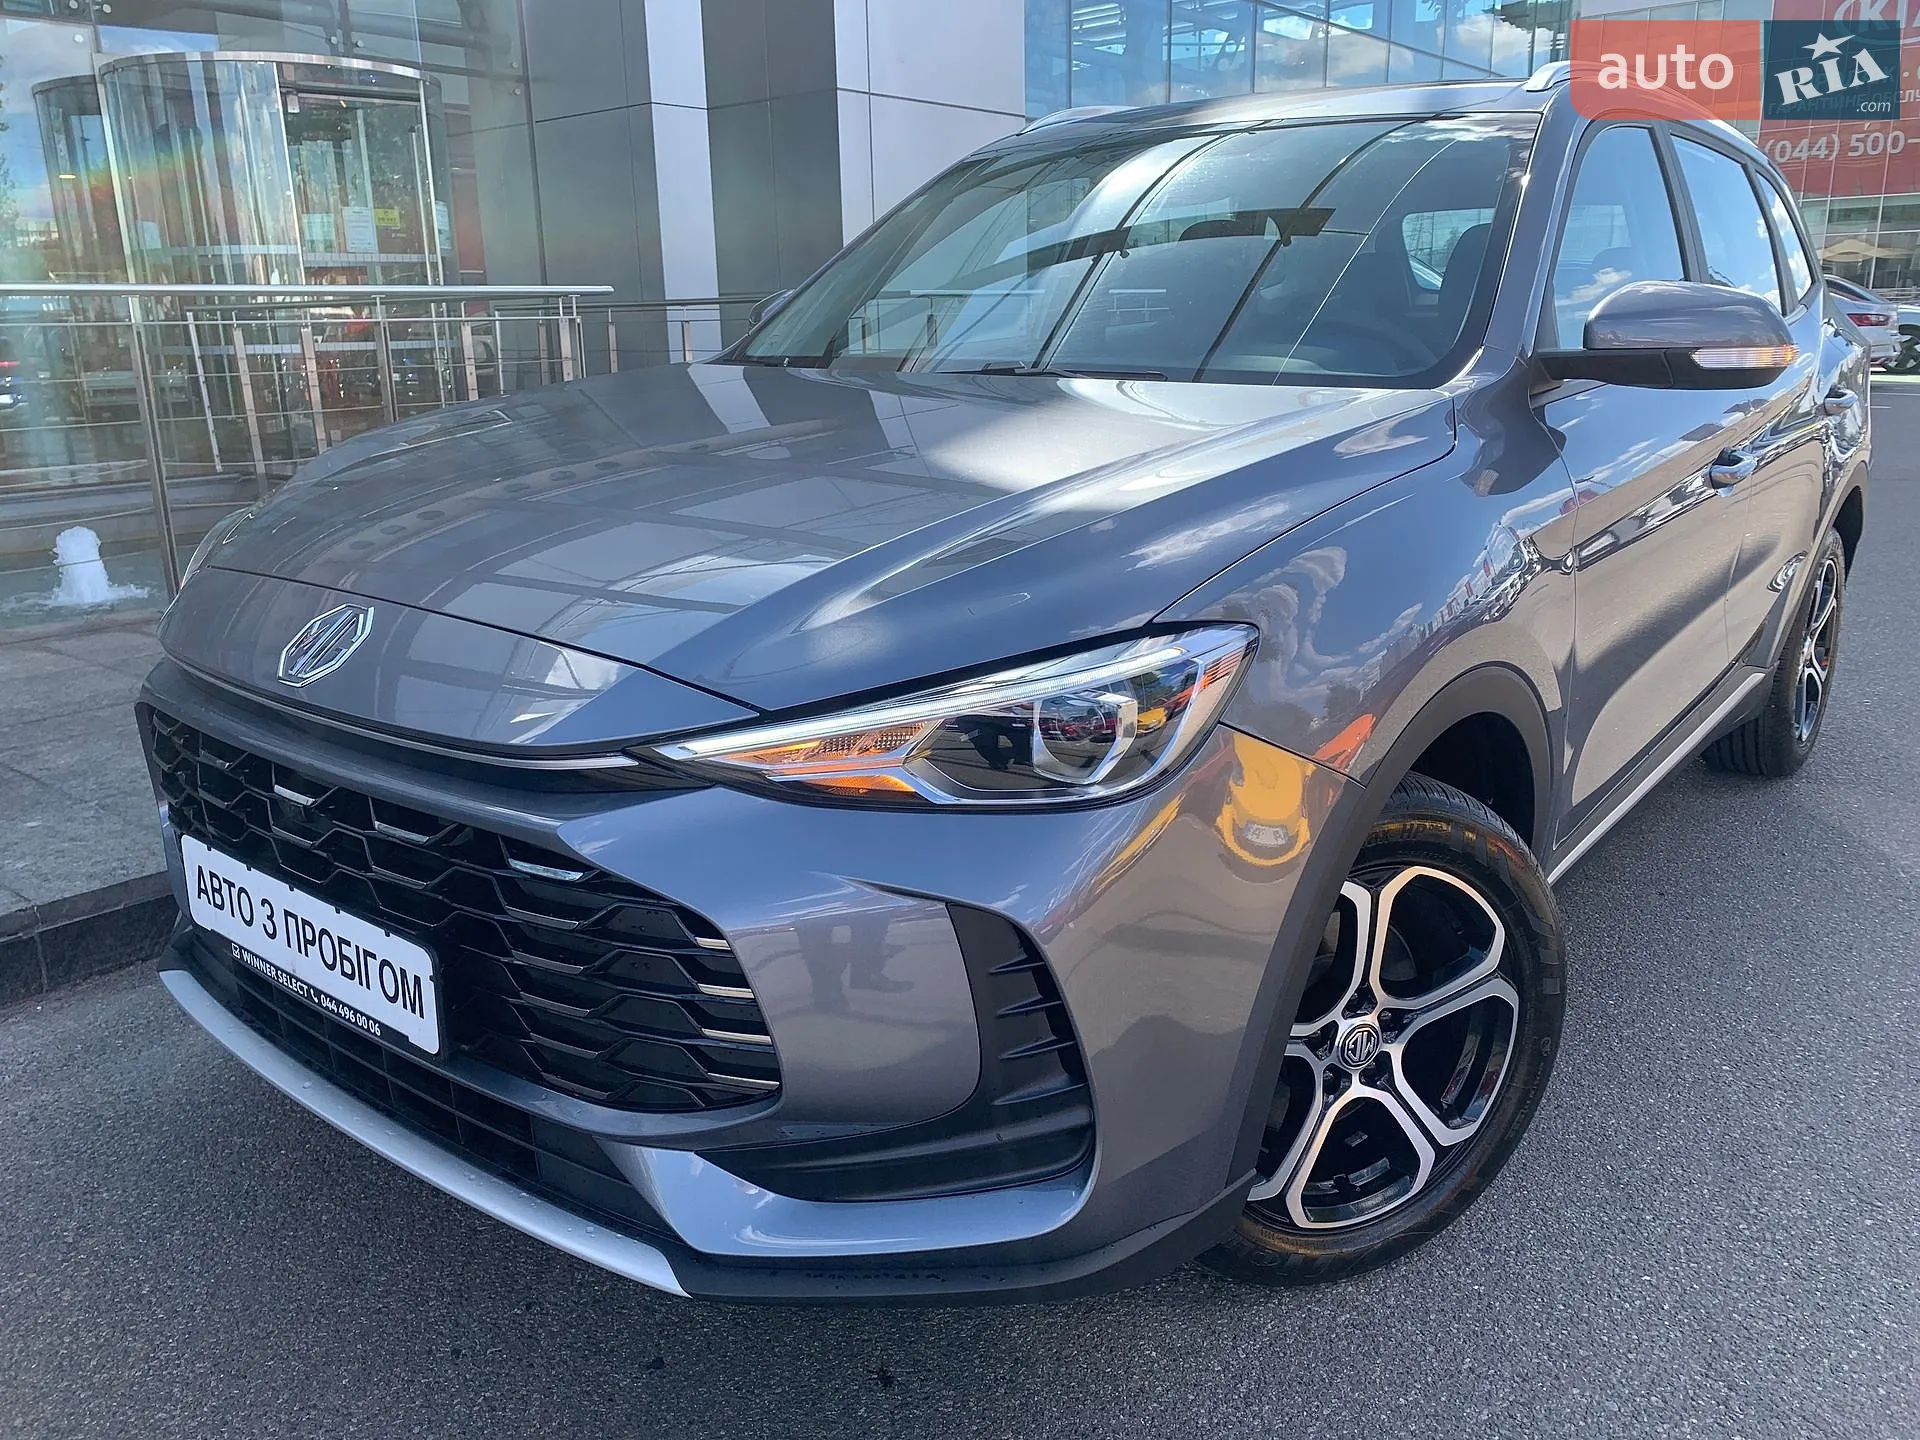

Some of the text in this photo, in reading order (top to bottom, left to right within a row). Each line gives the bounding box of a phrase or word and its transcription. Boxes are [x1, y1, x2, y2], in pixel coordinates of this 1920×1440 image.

[1765, 133, 1841, 163] (044)
[197, 865, 254, 927] АВТО
[284, 909, 424, 1019] ПРОБІГОМ
[241, 949, 381, 1037] WINNER SELECT 044 496 00 06
